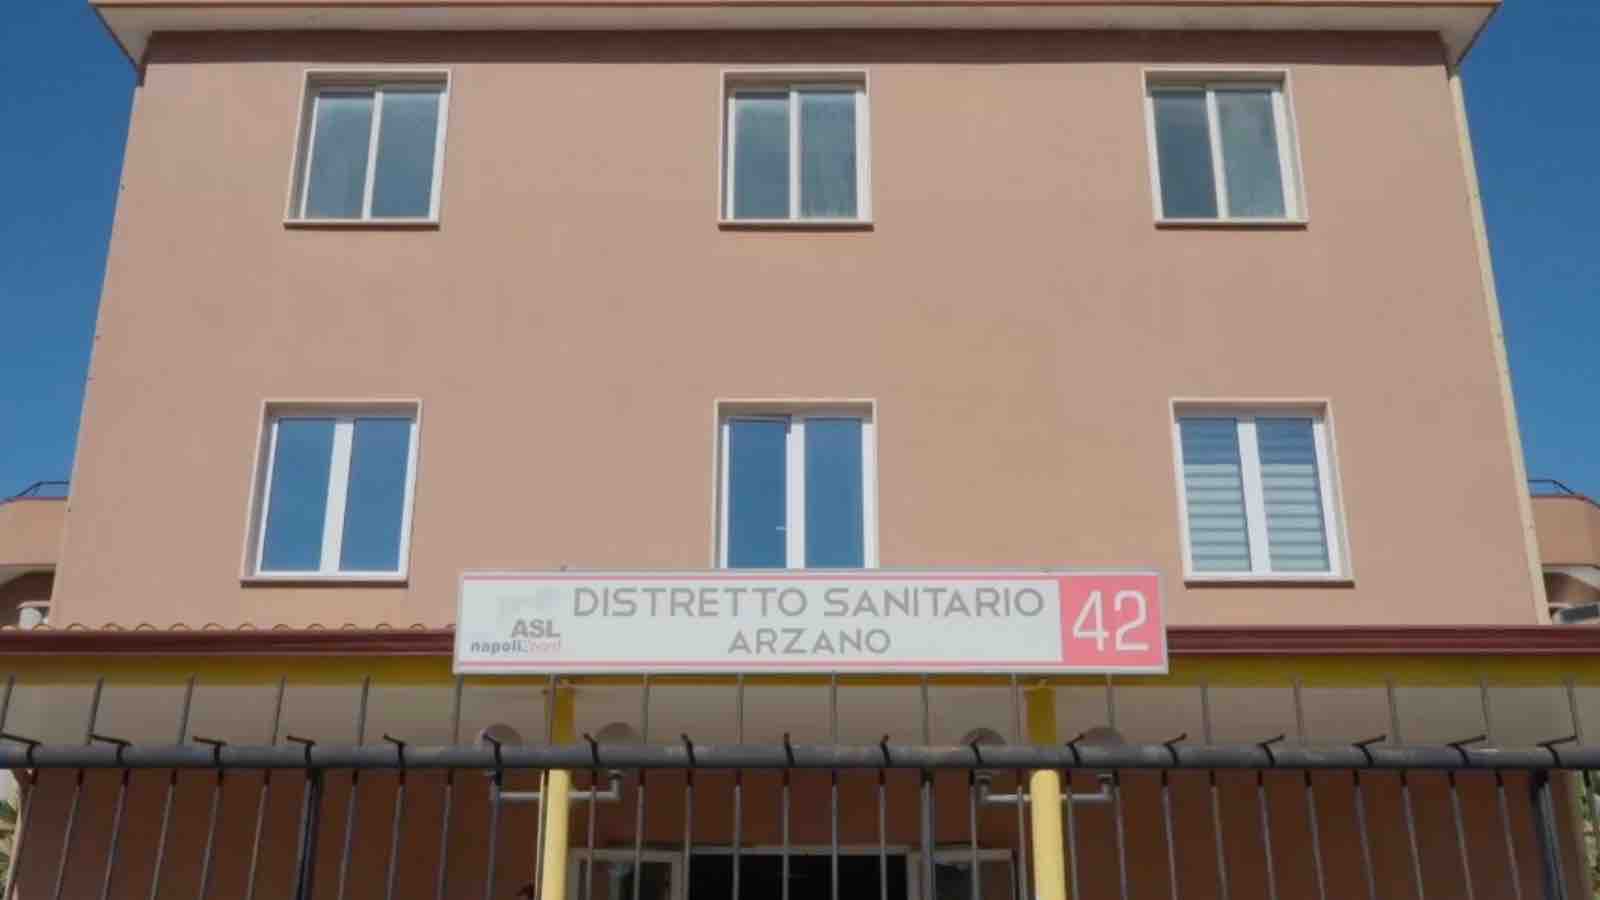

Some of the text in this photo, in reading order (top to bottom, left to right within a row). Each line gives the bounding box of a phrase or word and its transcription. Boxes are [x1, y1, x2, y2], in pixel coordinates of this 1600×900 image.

[573, 586, 1045, 617] DISTRETTO SANITARIO
[510, 618, 561, 639] ASL
[1072, 588, 1150, 653] 42
[727, 628, 892, 655] ARZANO
